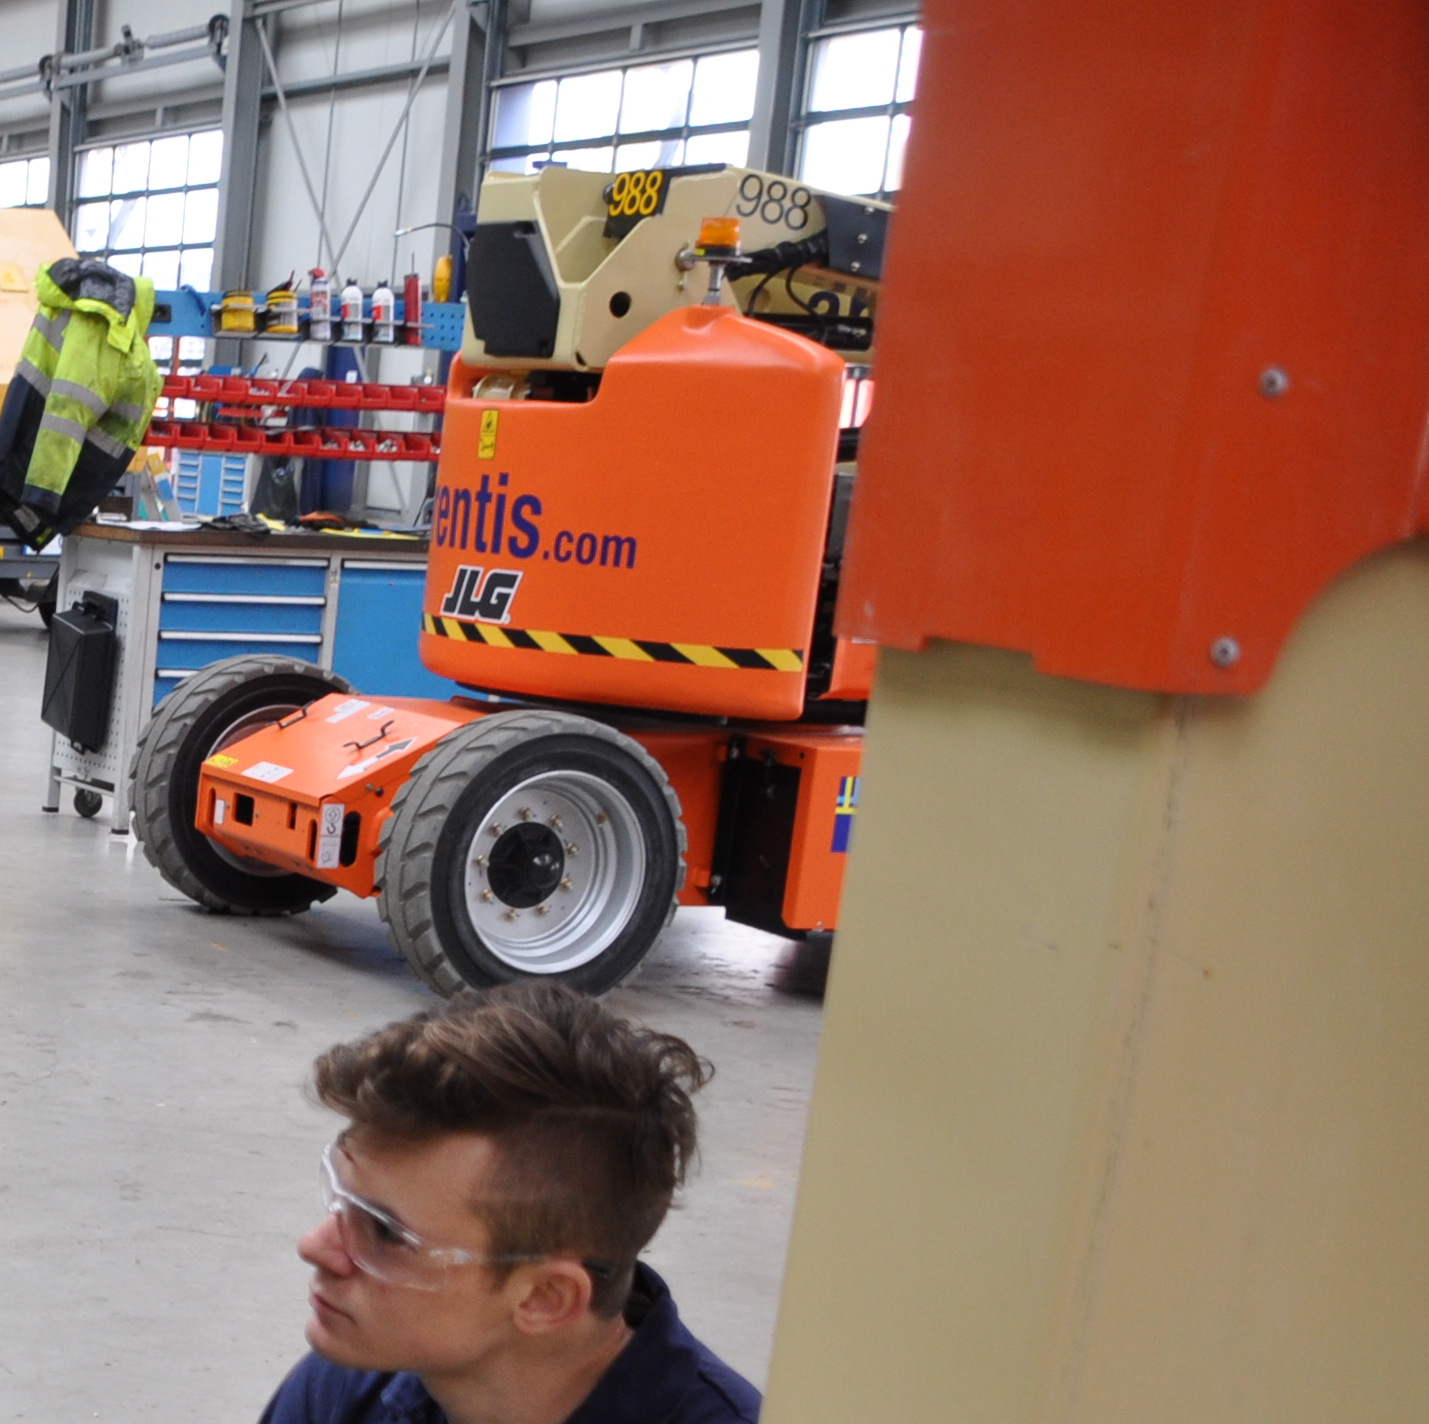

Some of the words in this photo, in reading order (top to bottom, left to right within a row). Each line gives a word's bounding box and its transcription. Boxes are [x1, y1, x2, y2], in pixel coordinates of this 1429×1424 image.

[608, 170, 663, 217] 988
[735, 173, 812, 231] 988
[441, 565, 523, 623] JLG
